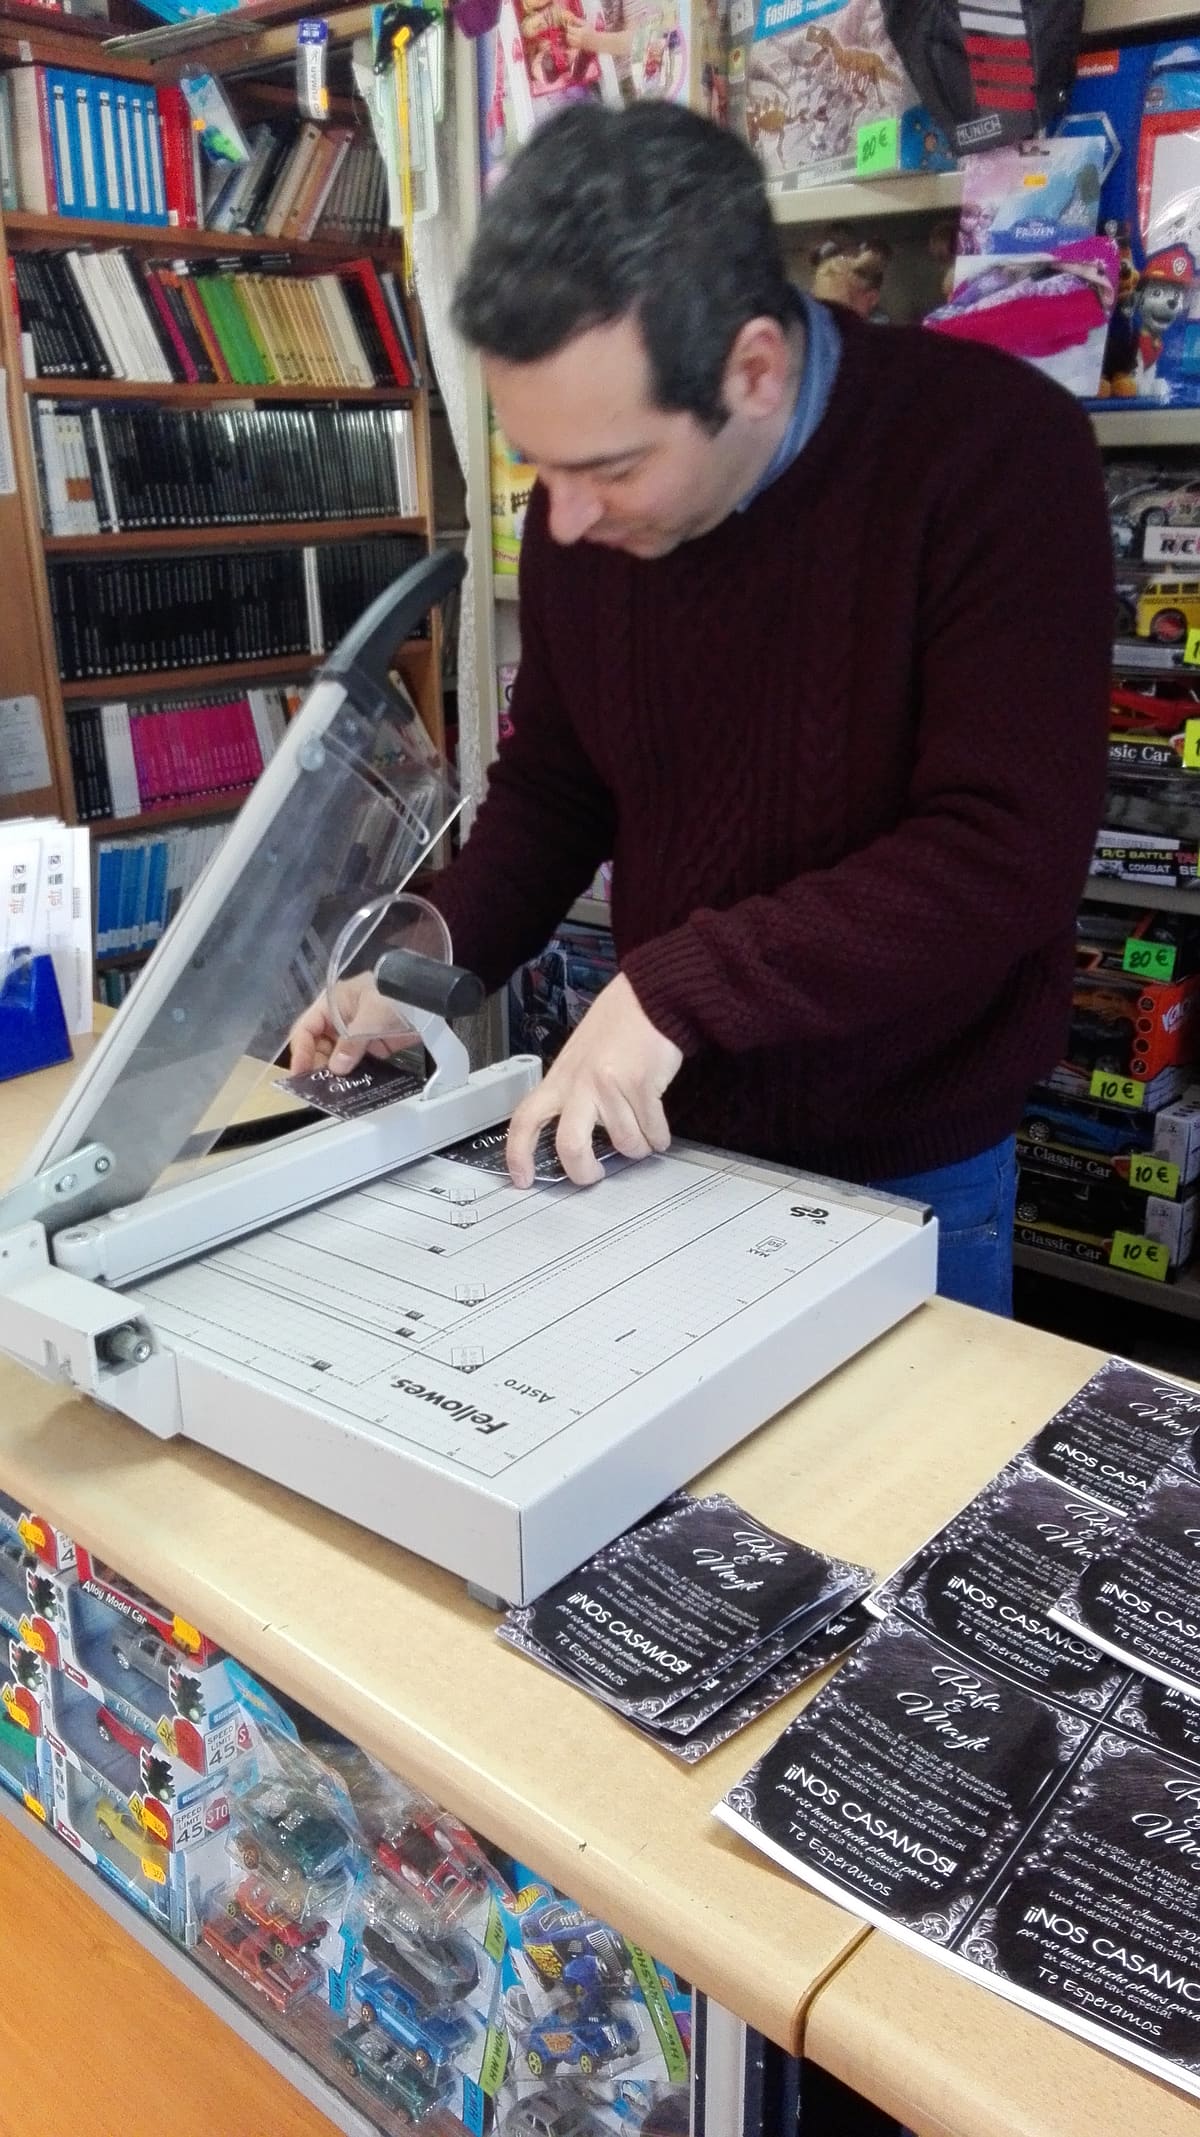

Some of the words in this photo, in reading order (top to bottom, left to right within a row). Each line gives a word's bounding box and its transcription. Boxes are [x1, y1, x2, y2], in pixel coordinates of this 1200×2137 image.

[957, 117, 1001, 141] MUNICH
[1142, 746, 1172, 762] Car
[1128, 851, 1174, 860] BATTLE
[1128, 863, 1172, 874] COMBAT
[1155, 949, 1170, 966] €
[1100, 1081, 1118, 1098] 10
[1122, 1082, 1135, 1098] €
[1033, 1145, 1084, 1170] Classic
[1086, 1161, 1113, 1178] Car
[1135, 1166, 1153, 1183] 10
[1157, 1167, 1170, 1184] €
[1020, 1228, 1073, 1252] Classic
[1076, 1244, 1102, 1261] Car
[1122, 1244, 1143, 1261] 10
[1146, 1246, 1159, 1262] €
[503, 1378, 556, 1404] Astro
[390, 1378, 510, 1436] Fellowes
[61, 1549, 75, 1563] 4
[82, 1580, 105, 1601] Alloy
[105, 1593, 132, 1615] Model
[131, 1608, 148, 1625] Car
[1113, 1623, 1131, 1640] Te
[555, 1631, 571, 1646] Te
[568, 1642, 629, 1687] Esperamos
[956, 1619, 974, 1636] Te
[974, 1632, 1051, 1678] Esperamos
[931, 1665, 1004, 1713] Rafa
[943, 1699, 967, 1713] &
[896, 1692, 990, 1752] Mayte
[207, 1725, 235, 1746] SPEED
[210, 1735, 232, 1752] LIMIT
[208, 1741, 236, 1767] 45
[955, 1767, 1008, 1799] Talamanca
[955, 1777, 1013, 1811] Torrelaguna
[175, 1806, 203, 1826] SPEED
[206, 1804, 231, 1824] STO
[918, 1798, 950, 1818] 2017
[175, 1821, 204, 1845] 45
[178, 1814, 201, 1832] LIMIT
[888, 1803, 927, 1830] marcha
[927, 1826, 968, 1852] nupcial
[775, 1783, 798, 1798] por
[810, 1802, 844, 1831] hemos
[900, 1863, 931, 1883] para
[929, 1878, 945, 1891] ti
[809, 1817, 830, 1835] este
[846, 1843, 866, 1859] tan
[864, 1855, 906, 1883] especial
[787, 1821, 808, 1841] Te
[808, 1836, 893, 1897] Esperamos
[1094, 1847, 1106, 1857] de
[1142, 1870, 1155, 1880] de
[1156, 1876, 1199, 1901] Henares
[1153, 1866, 1193, 1889] Manjar
[1048, 1889, 1075, 1906] Una
[1143, 1939, 1189, 1964] marcha
[1015, 1927, 1040, 1942] por
[1040, 1938, 1060, 1952] eso
[1059, 1946, 1097, 1969] hemos
[1095, 1965, 1129, 1986] hecho
[1091, 1937, 1200, 2003] CASAMO
[1042, 1952, 1058, 1963] en
[1059, 1960, 1081, 1976] este
[1104, 1982, 1127, 1997] tan
[1127, 1994, 1174, 2020] especial
[1038, 1965, 1060, 1986] Te
[1062, 1979, 1164, 2037] Esperamos
